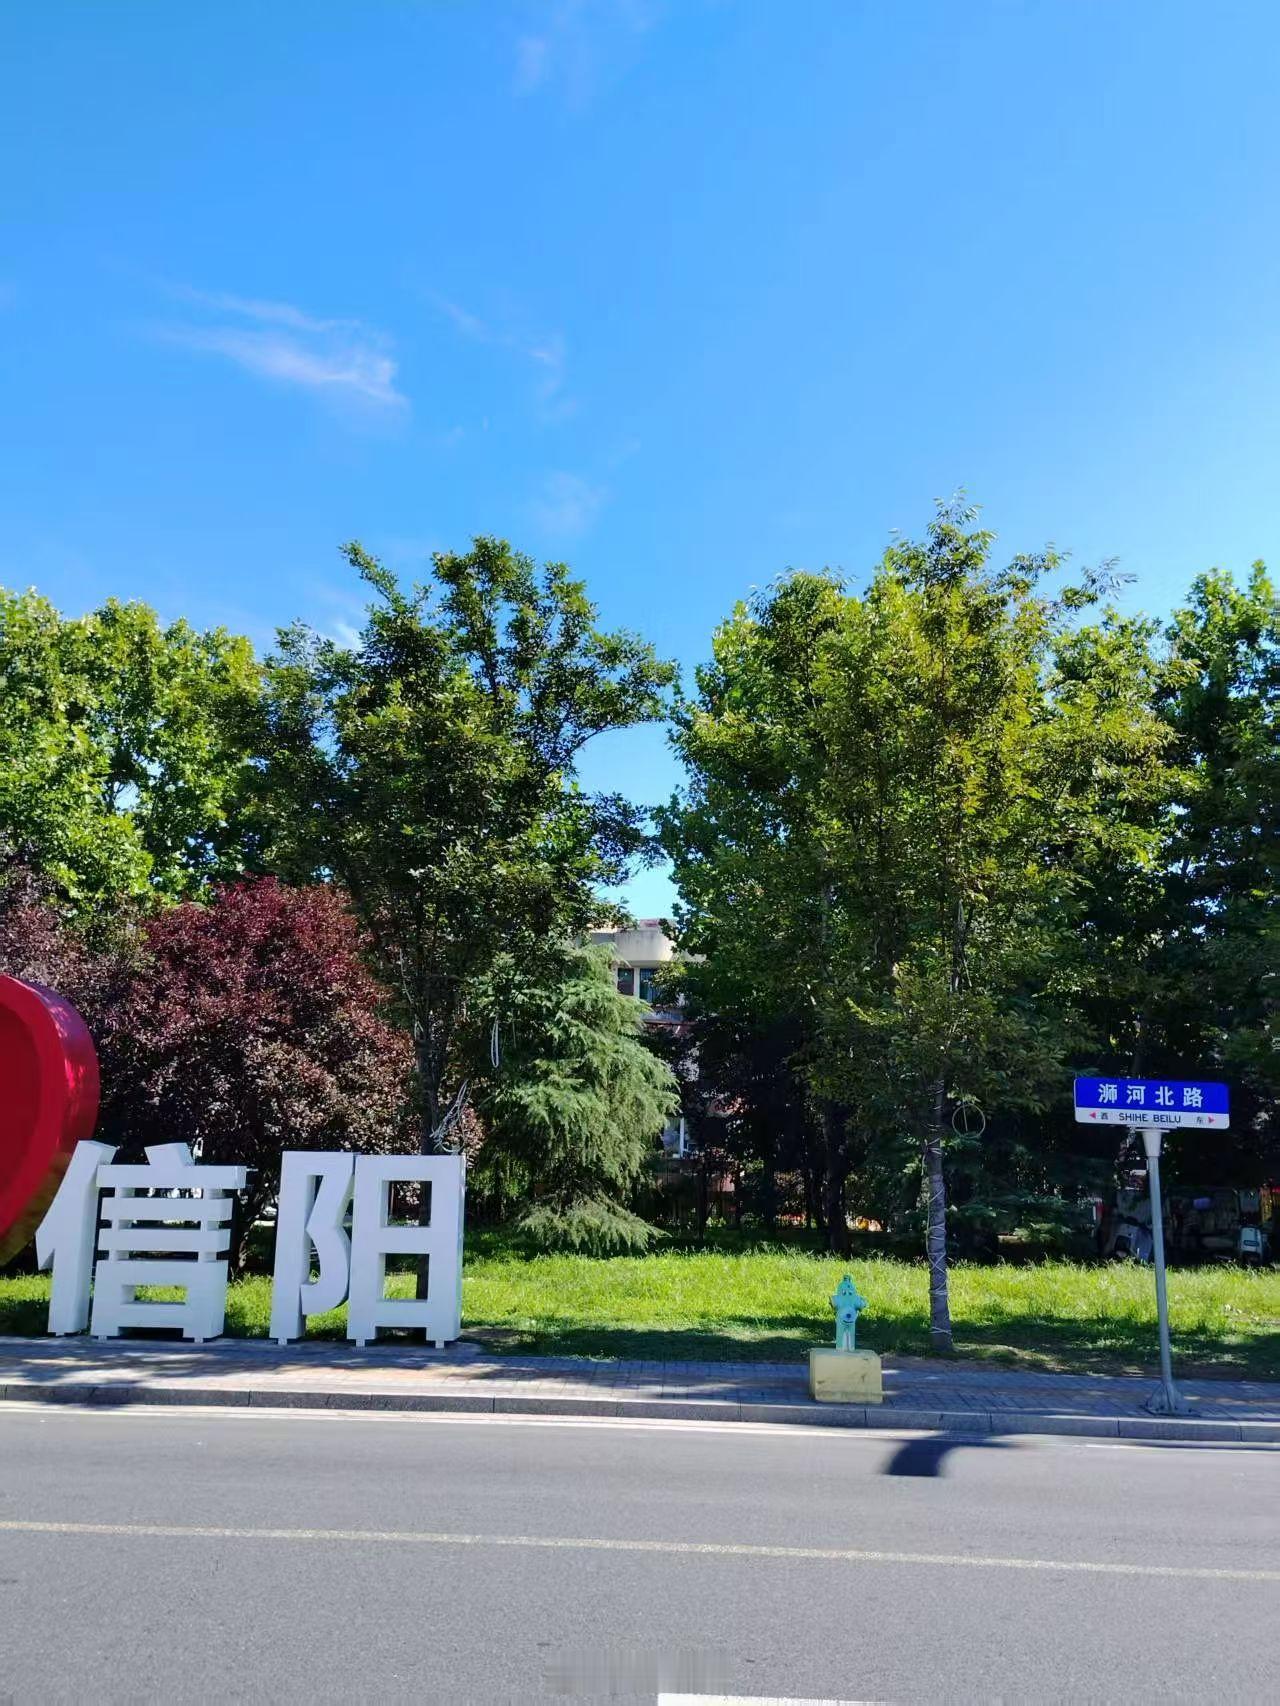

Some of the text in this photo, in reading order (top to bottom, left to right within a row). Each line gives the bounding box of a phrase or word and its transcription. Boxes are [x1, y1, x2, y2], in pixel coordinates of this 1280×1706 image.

[1098, 1083, 1203, 1107] 浉河北路
[1118, 1112, 1181, 1123] SHIHE BEILU
[35, 1140, 465, 1347] 信阳
